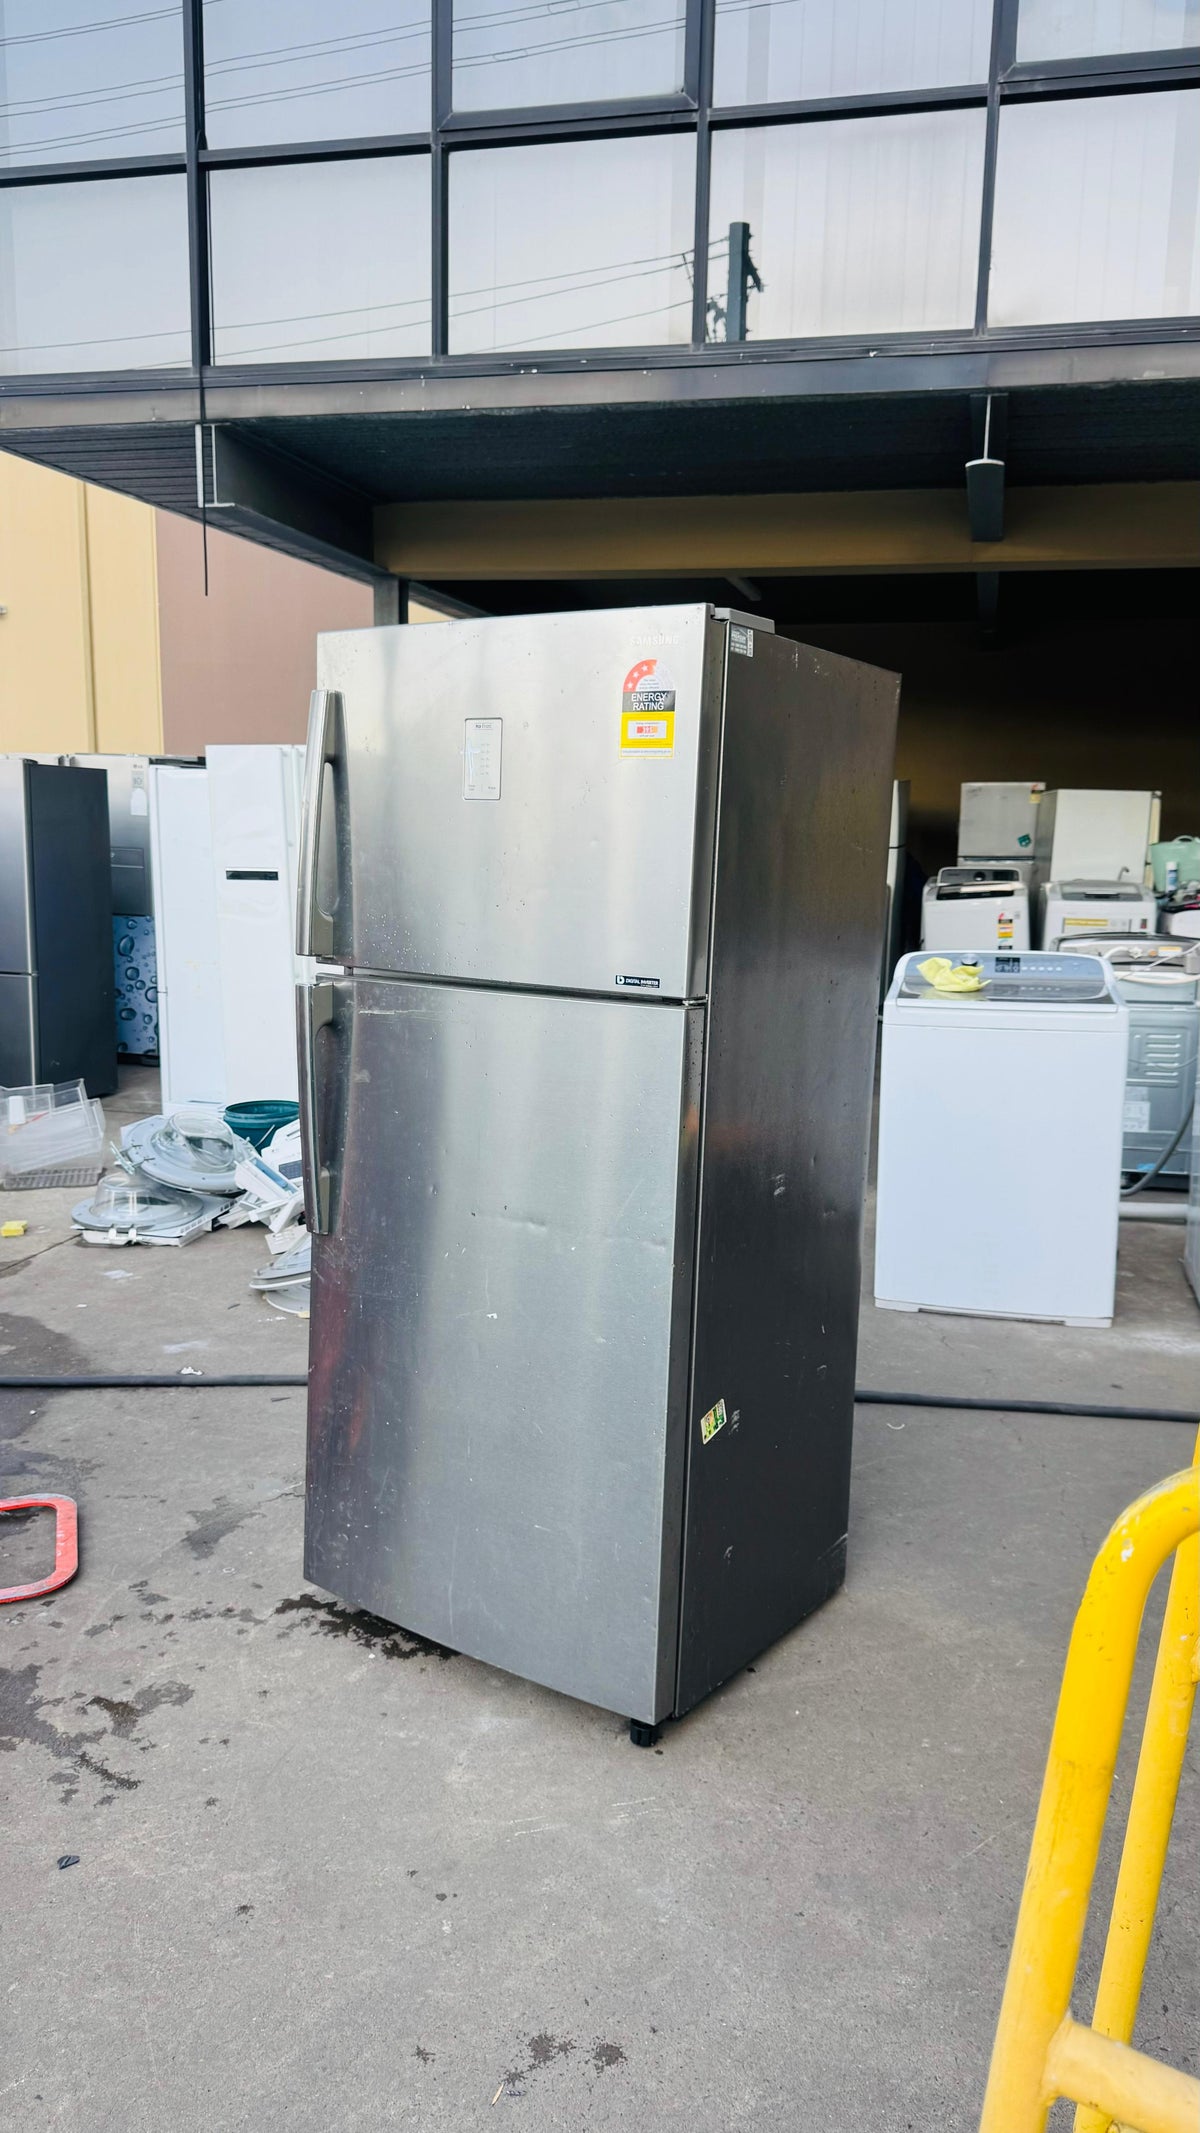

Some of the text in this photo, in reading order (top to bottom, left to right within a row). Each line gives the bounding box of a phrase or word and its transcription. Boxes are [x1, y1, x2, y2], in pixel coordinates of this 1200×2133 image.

[630, 634, 679, 646] SAMSUNG
[631, 692, 667, 702] ENERGY
[632, 702, 665, 711] RATING
